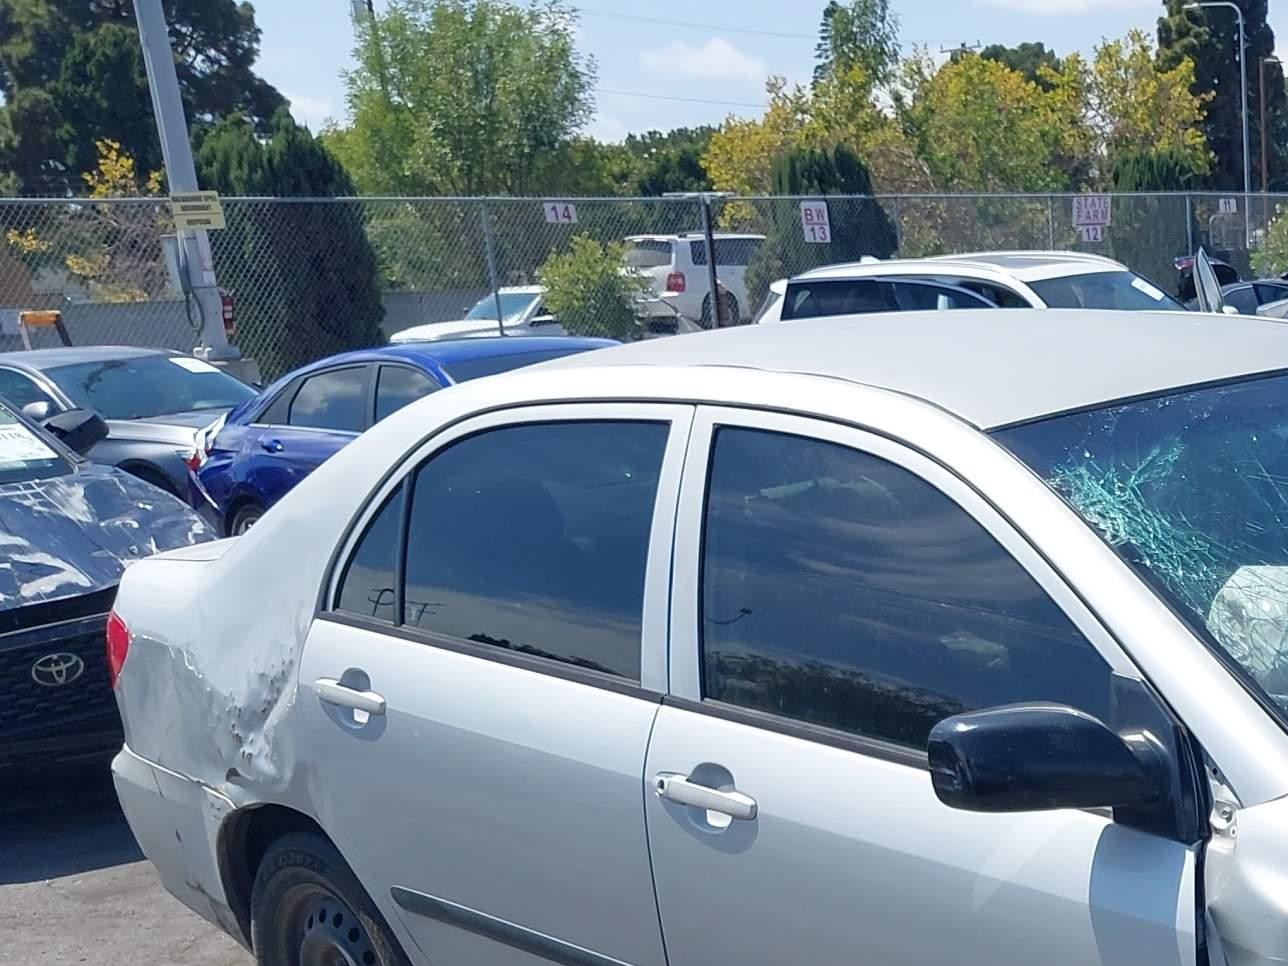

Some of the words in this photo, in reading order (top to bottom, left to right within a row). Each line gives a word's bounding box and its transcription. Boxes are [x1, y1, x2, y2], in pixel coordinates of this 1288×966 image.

[1075, 198, 1109, 209] STATE
[550, 205, 572, 221] 14
[804, 208, 825, 221] BW
[1077, 209, 1108, 221] FARM
[810, 226, 828, 240] 13
[1086, 227, 1099, 240] 12
